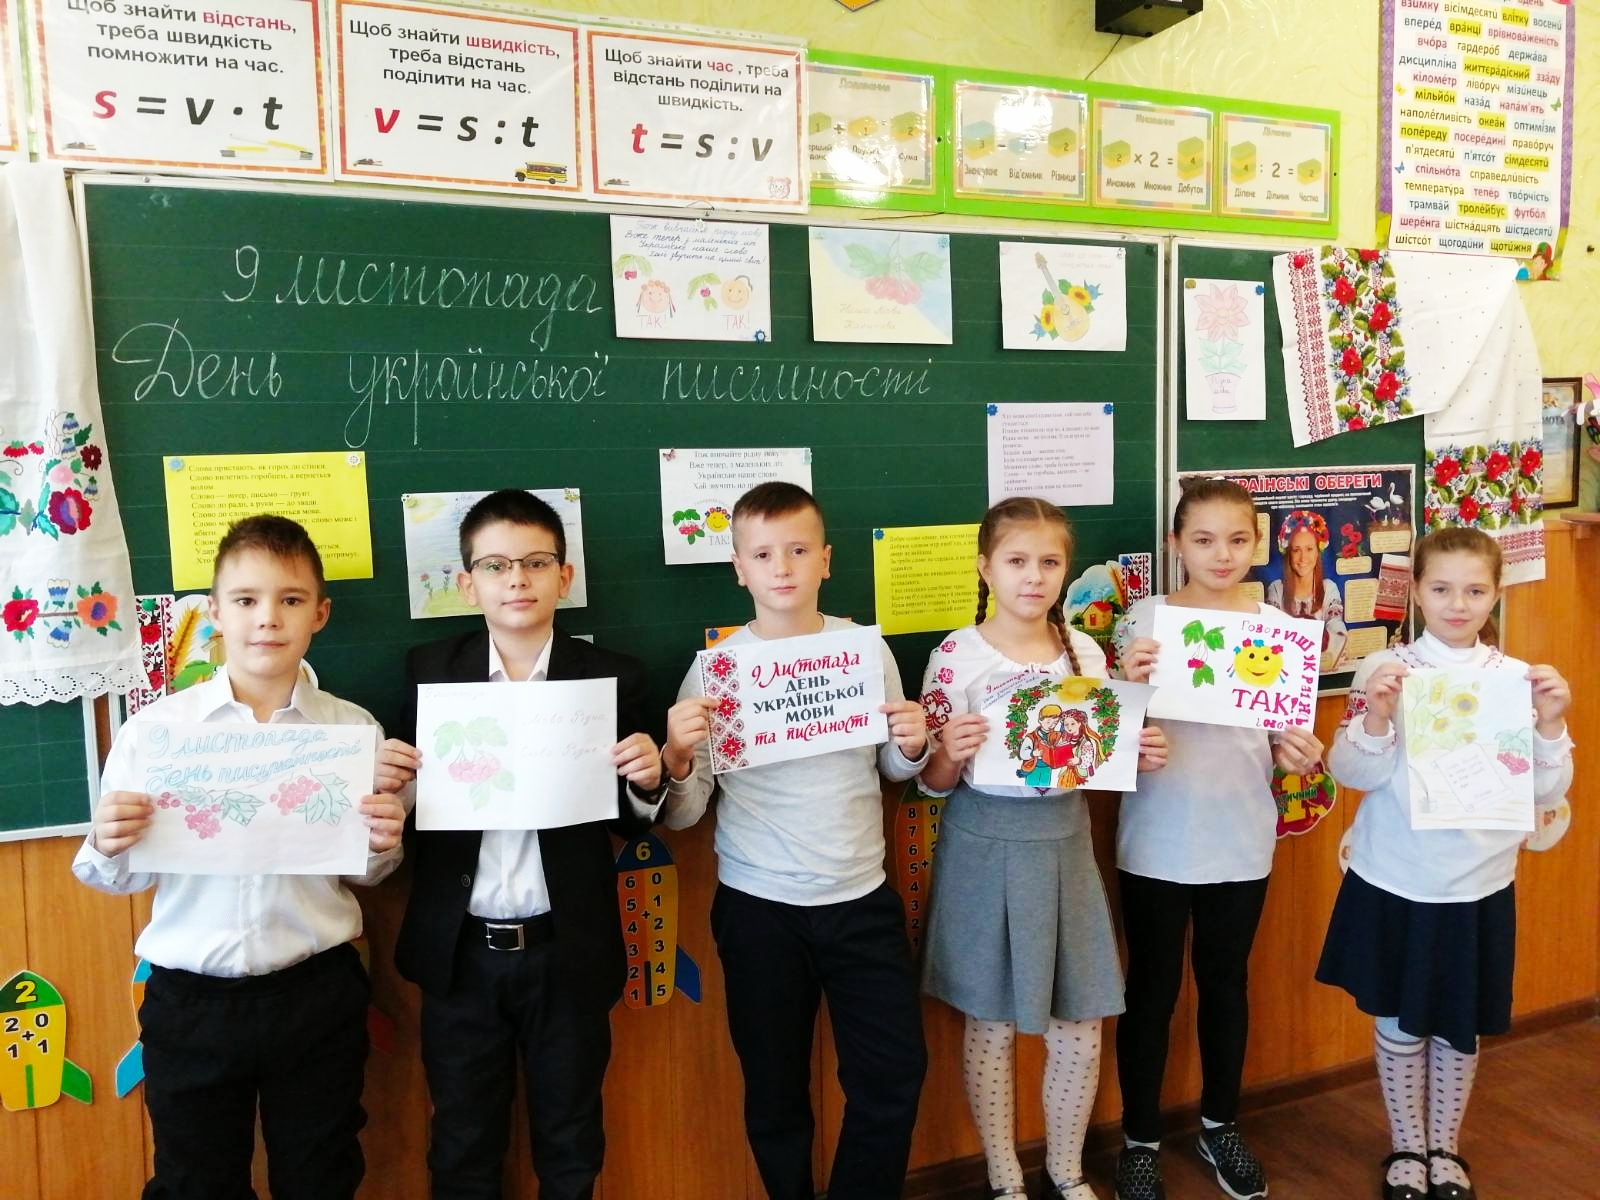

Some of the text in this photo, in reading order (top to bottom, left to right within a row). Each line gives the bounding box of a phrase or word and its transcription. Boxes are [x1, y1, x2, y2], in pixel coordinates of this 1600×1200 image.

[67, 0, 297, 34] Щоб знайти відстань,
[97, 24, 273, 51] треба швидкість
[350, 20, 560, 59] Щоб знайти швидкість,
[88, 46, 284, 74] помножити на час.
[389, 47, 525, 73] треба відстань
[605, 48, 642, 64] Щоб
[647, 54, 702, 70] знайти
[706, 61, 733, 73] час
[746, 64, 789, 79] треба
[383, 68, 531, 94] поділити на час.
[614, 71, 782, 96] відстань поділити на
[185, 97, 214, 126] v
[263, 96, 283, 130] t
[658, 94, 743, 112] швидкість.
[374, 107, 400, 134] v
[456, 114, 479, 142] s
[521, 116, 539, 148] t
[630, 123, 648, 154] t
[695, 132, 715, 160] s
[752, 136, 774, 162] v
[1149, 151, 1159, 168] 2
[1272, 162, 1281, 178] 2
[222, 245, 603, 352] 9 листопада
[112, 318, 934, 449] День української писемності
[1315, 473, 1382, 490] ОБЕРЕГИ
[752, 665, 762, 684] 9
[785, 675, 831, 694] ДЕНЬ
[753, 682, 866, 714] УКРАЇНСЬКОЇ
[1232, 689, 1299, 716] ТАК!
[785, 704, 835, 725] МОВИ
[149, 724, 170, 758] 9
[754, 731, 776, 746] та
[907, 804, 939, 820] 8 0
[908, 826, 918, 838] 7
[635, 841, 651, 861] 6
[908, 844, 918, 856] 6
[909, 862, 918, 875] 5
[625, 872, 662, 889] 6 0
[910, 880, 919, 893] 4
[626, 894, 662, 912] 5 1
[911, 899, 919, 912] 3
[627, 917, 664, 934] 4 2
[628, 940, 665, 957] 3 3
[629, 962, 666, 980] 2 4
[15, 980, 37, 1004] 2
[630, 984, 667, 1001] 1 5
[5, 1013, 49, 1033] 2 0
[7, 1039, 48, 1059] 1 1
